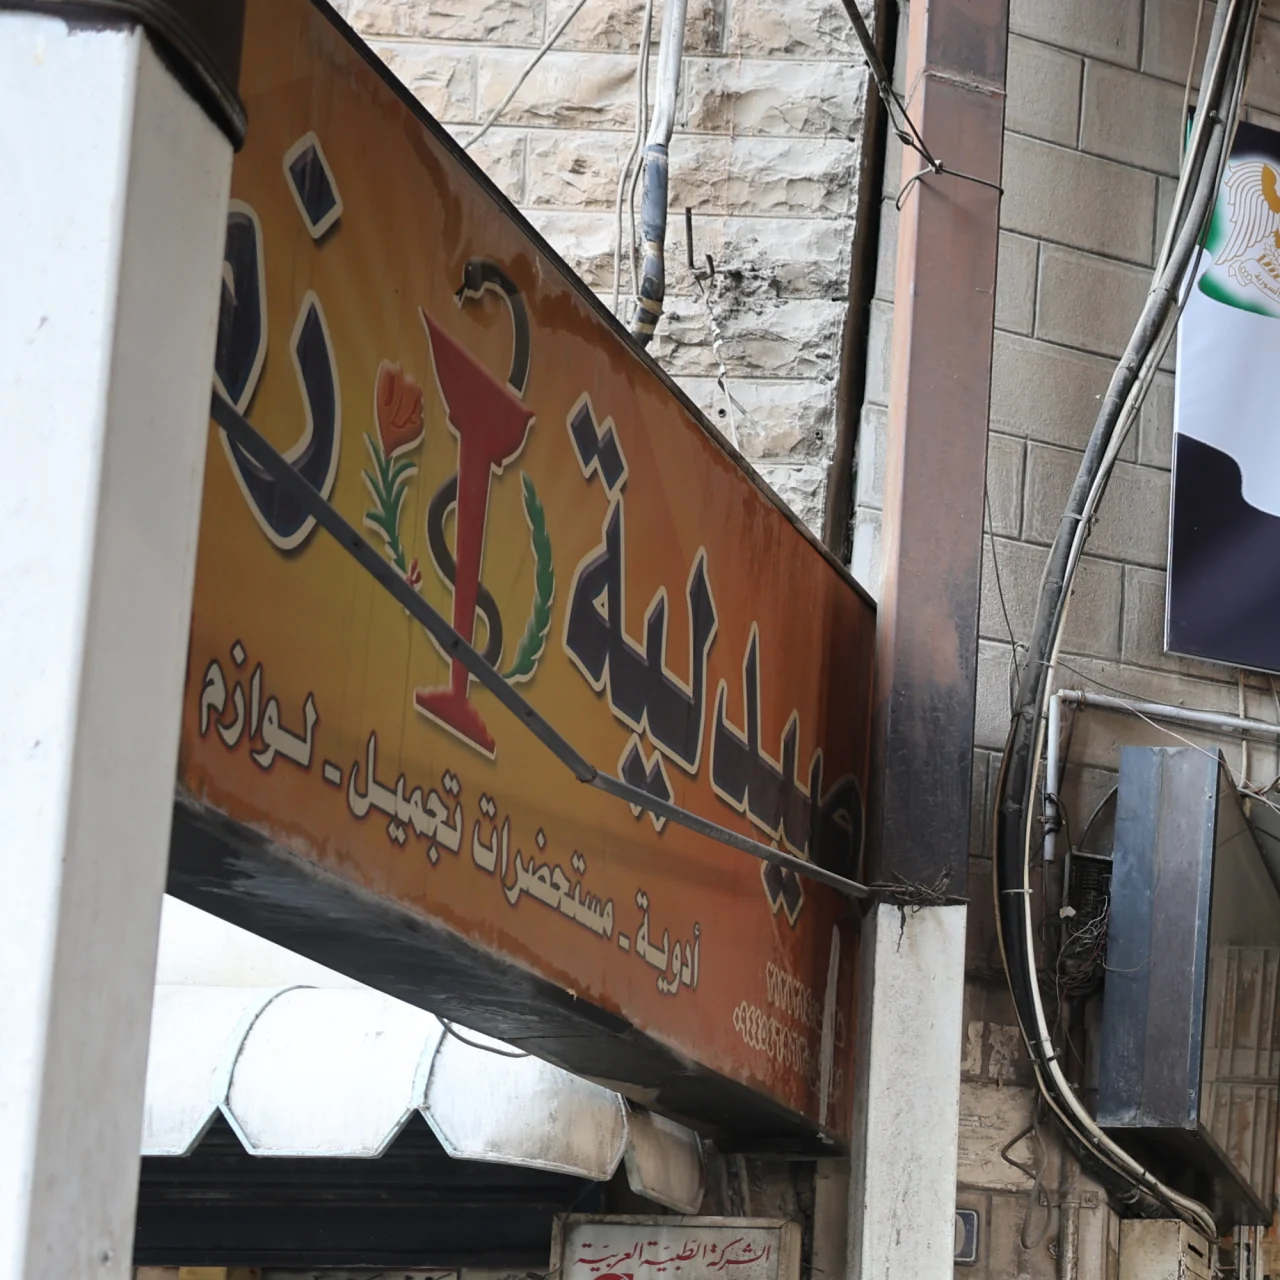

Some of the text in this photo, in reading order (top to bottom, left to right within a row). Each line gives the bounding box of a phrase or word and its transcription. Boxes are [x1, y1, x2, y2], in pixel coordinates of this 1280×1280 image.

[199, 638, 319, 771] لوازم
[562, 391, 864, 928] صيدلية
[347, 728, 463, 866] تجميل
[471, 792, 615, 941] مستحضرات
[635, 886, 701, 995] أدوية
[705, 1237, 772, 1272] الشركة
